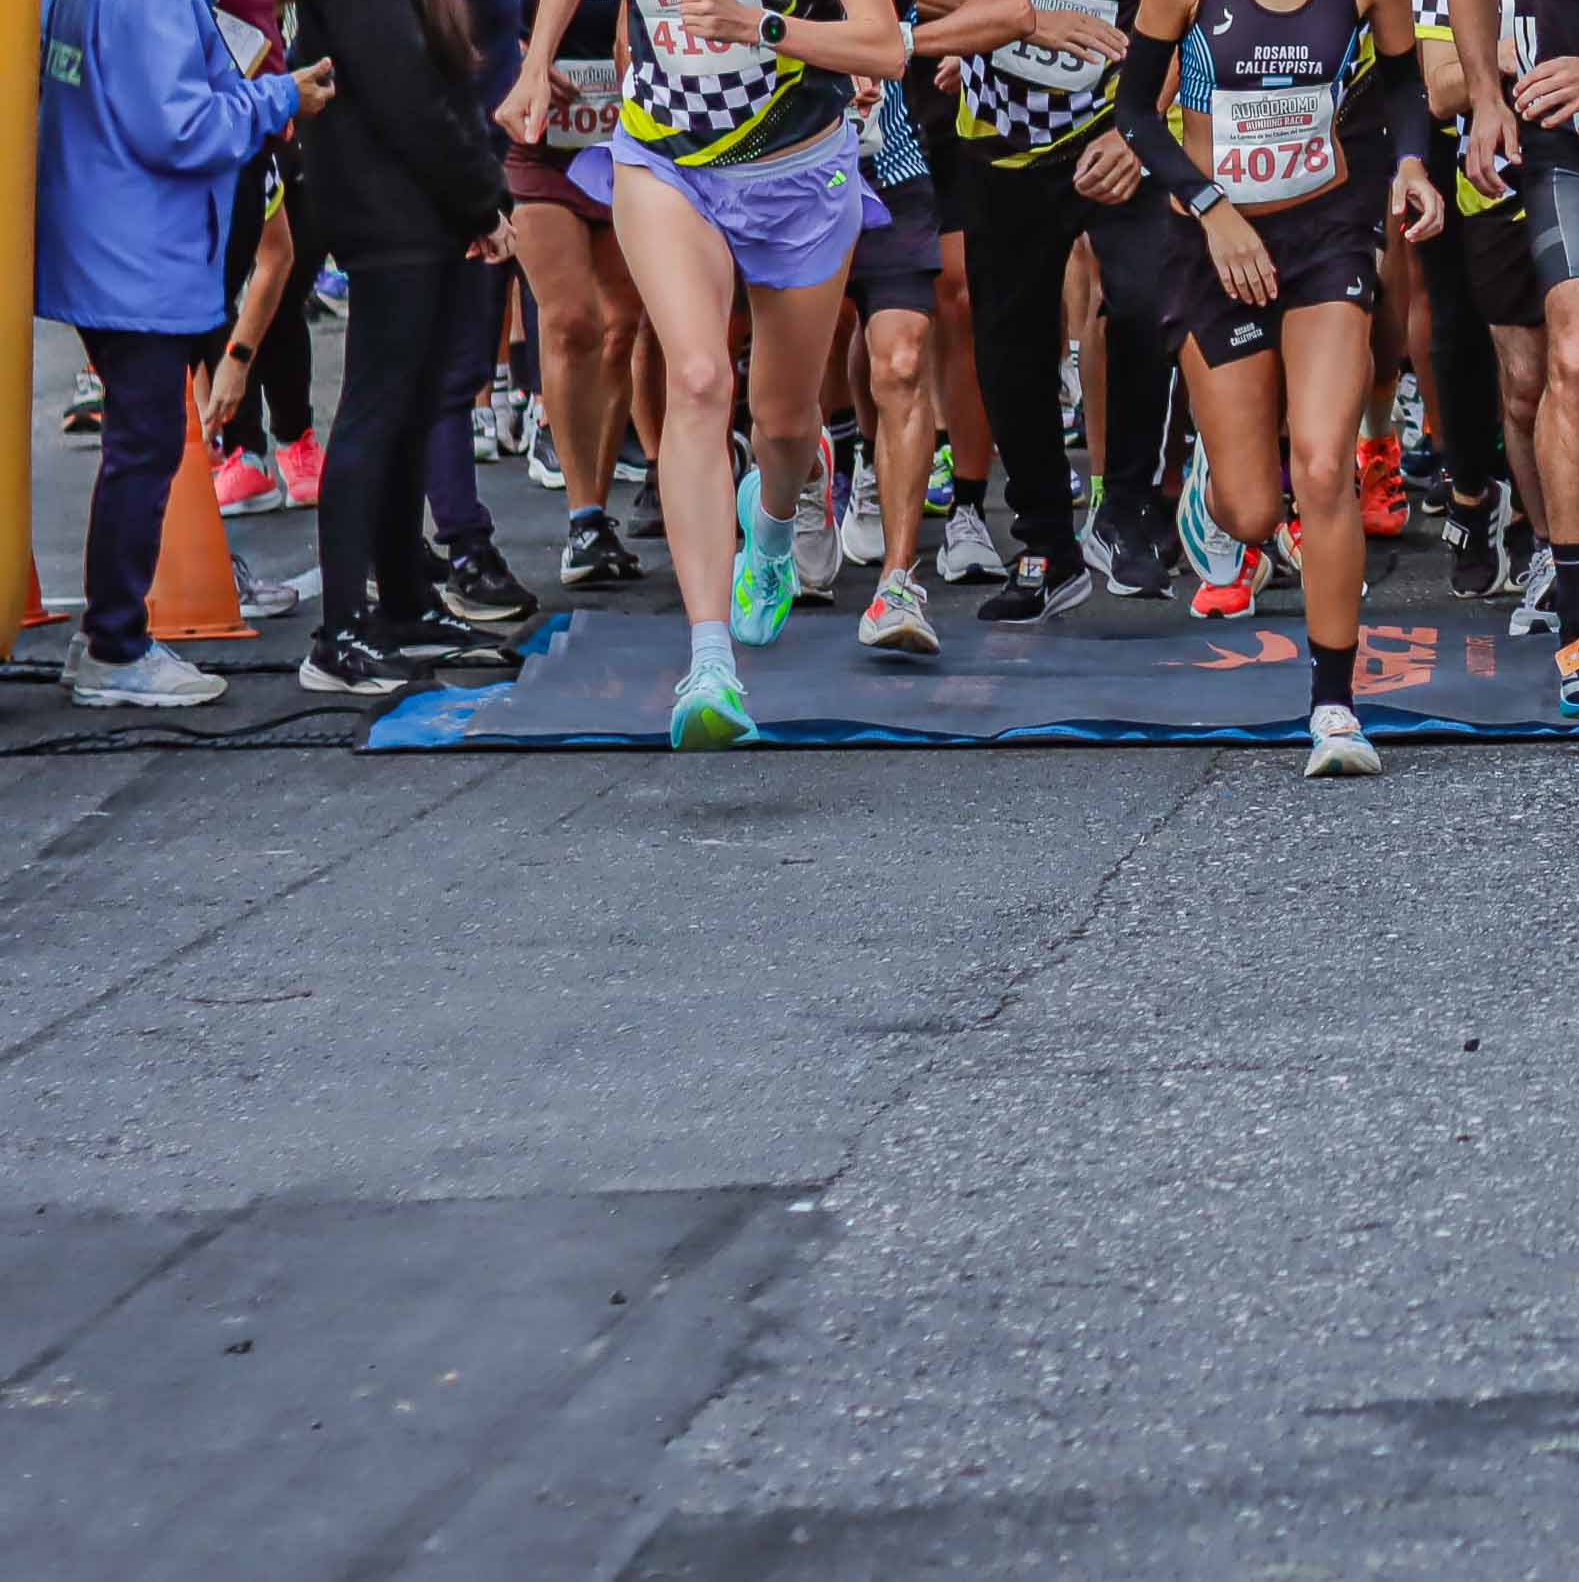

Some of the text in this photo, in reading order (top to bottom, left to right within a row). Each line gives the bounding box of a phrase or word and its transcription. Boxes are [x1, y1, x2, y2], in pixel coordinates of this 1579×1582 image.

[1254, 45, 1309, 61] ROSARIO
[1235, 61, 1323, 75] CALLEYPISTA
[1230, 96, 1319, 121] AUTÓDROMO
[1217, 137, 1329, 184] 4078
